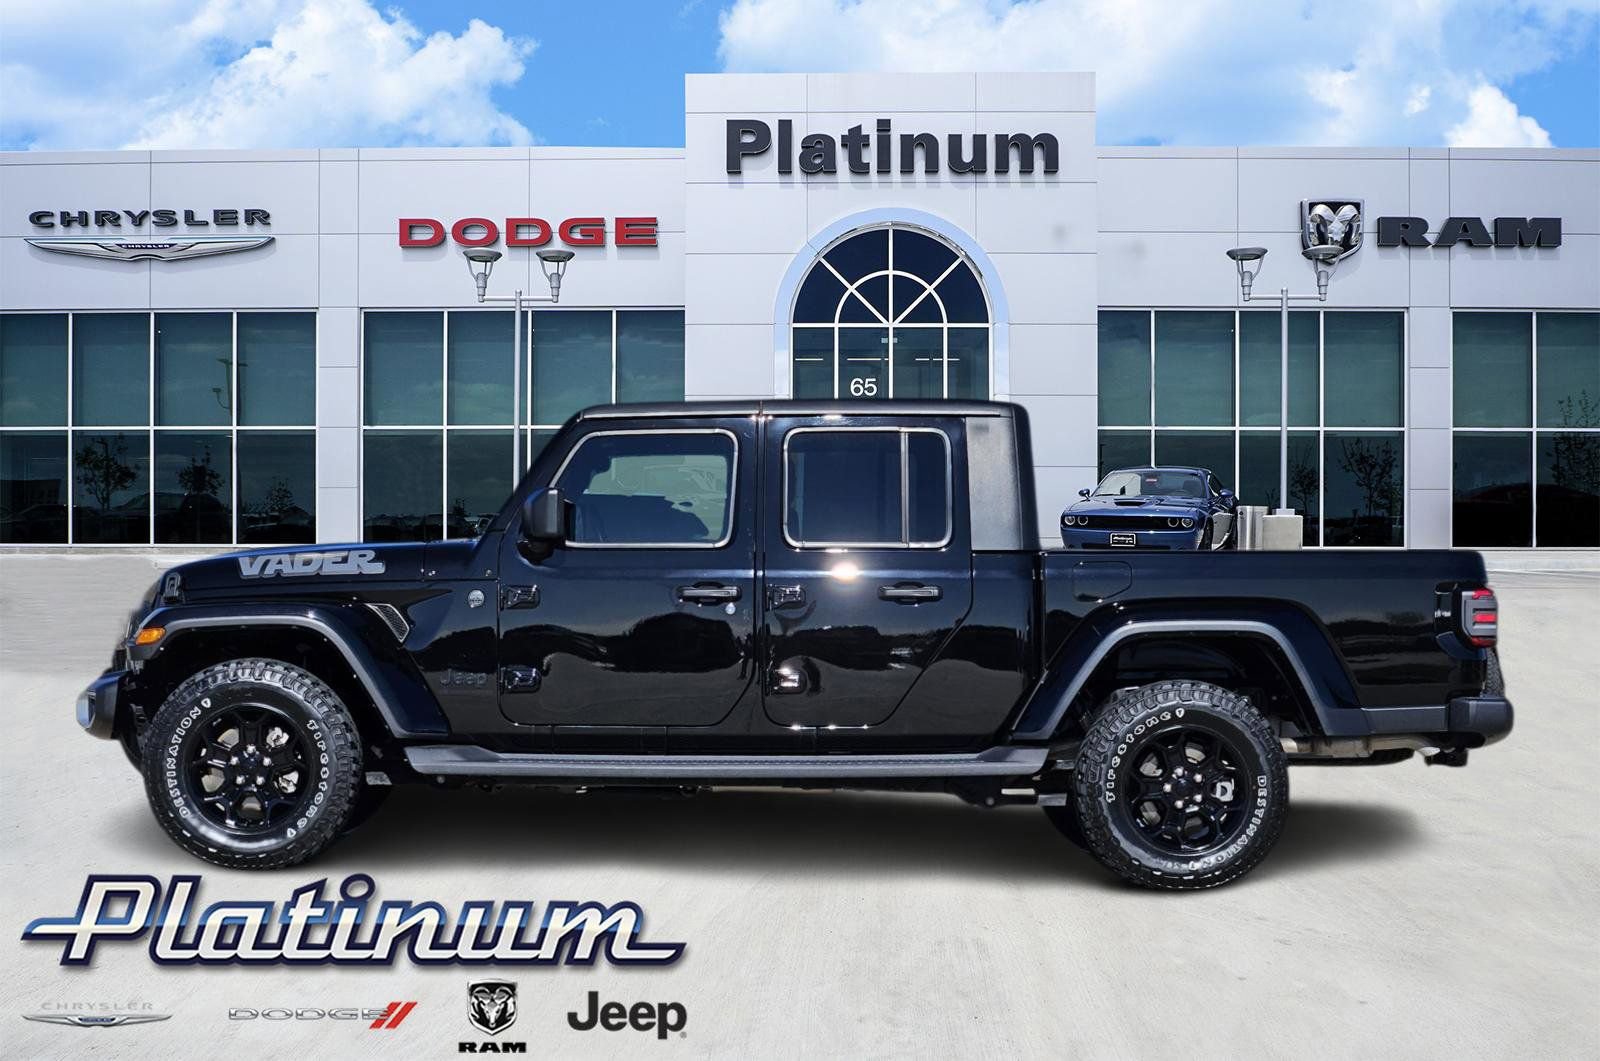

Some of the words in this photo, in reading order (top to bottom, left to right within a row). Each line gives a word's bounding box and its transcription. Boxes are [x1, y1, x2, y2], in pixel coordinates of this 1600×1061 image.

[725, 118, 1060, 175] Platinum
[28, 209, 272, 228] CHRYSLER
[398, 216, 658, 248] DODGE
[1377, 216, 1562, 248] RAM
[849, 377, 878, 397] 65
[238, 550, 386, 579] VADER
[440, 668, 489, 690] Jeep
